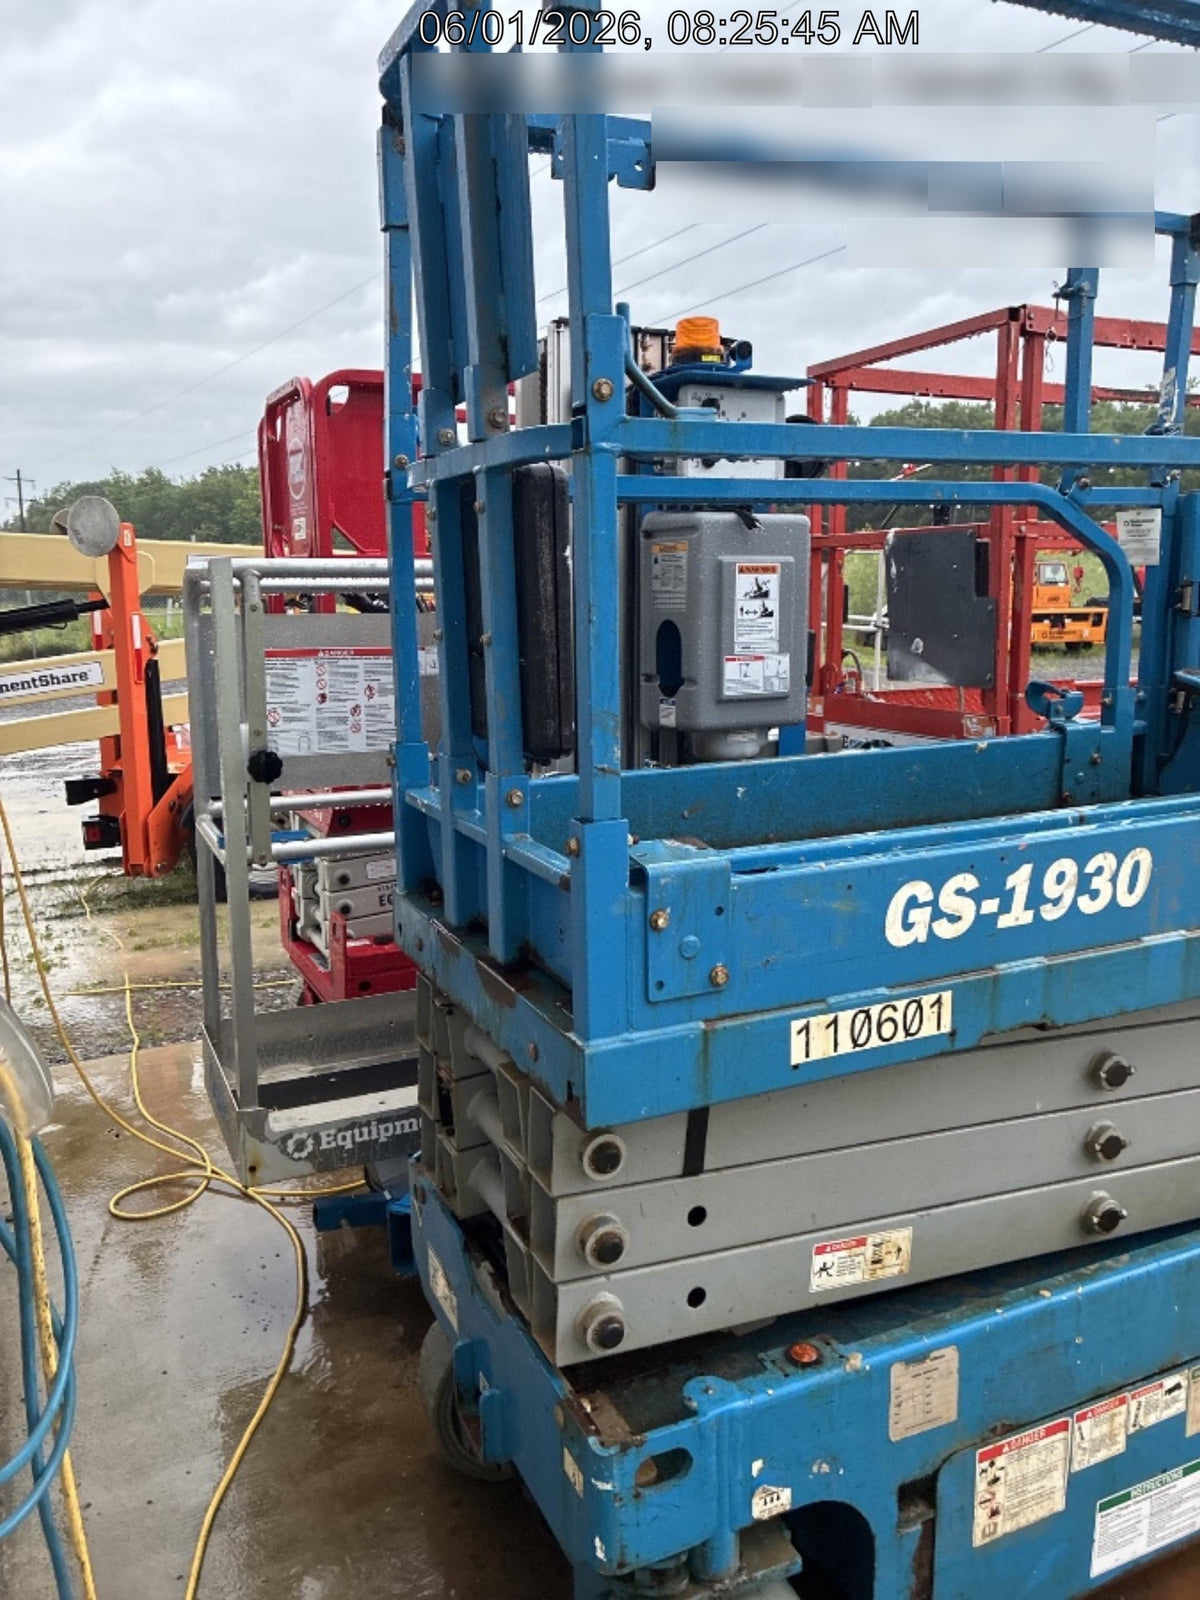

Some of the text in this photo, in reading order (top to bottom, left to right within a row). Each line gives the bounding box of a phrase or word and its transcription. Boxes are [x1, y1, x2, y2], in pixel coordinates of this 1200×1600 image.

[885, 847, 1152, 947] GS-1930
[796, 993, 943, 1059] 110601
[319, 1116, 422, 1150] Equipm
[1010, 1428, 1047, 1450] DANGER
